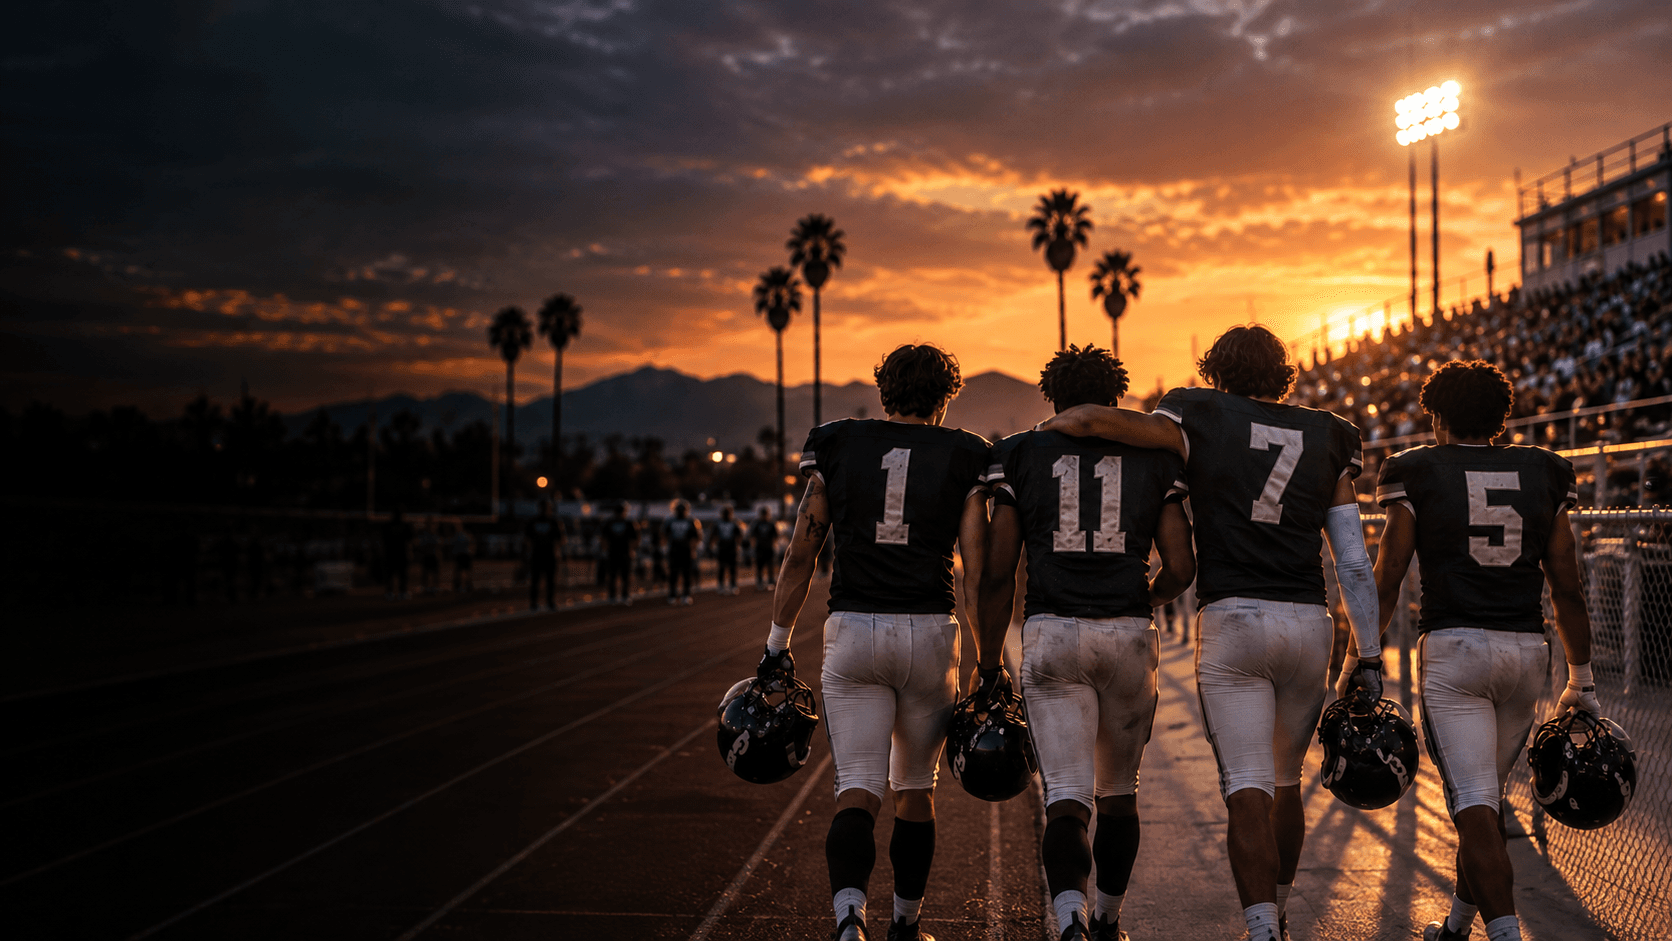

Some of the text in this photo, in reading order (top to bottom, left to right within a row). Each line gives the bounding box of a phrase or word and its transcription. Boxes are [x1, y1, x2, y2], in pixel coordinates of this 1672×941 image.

[875, 447, 911, 545] 1
[1052, 454, 1126, 554] 11
[1250, 421, 1304, 525] 7
[1465, 470, 1523, 567] 5
